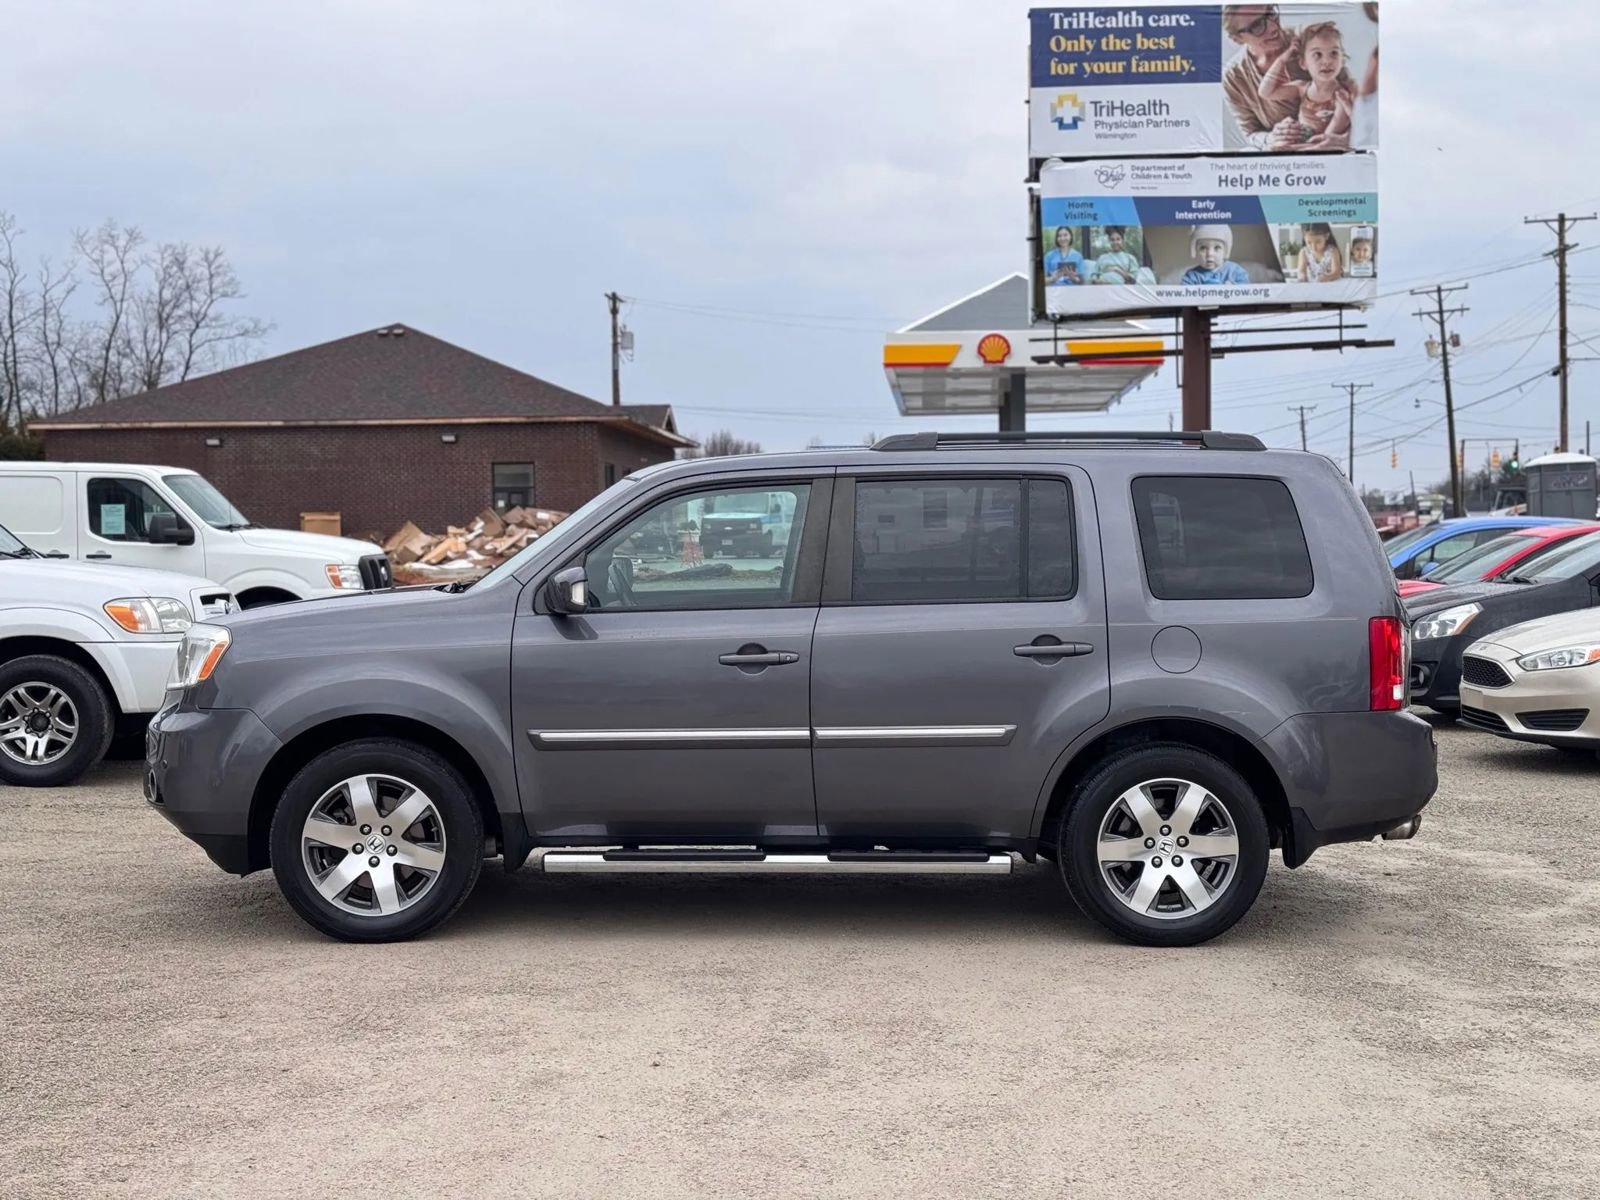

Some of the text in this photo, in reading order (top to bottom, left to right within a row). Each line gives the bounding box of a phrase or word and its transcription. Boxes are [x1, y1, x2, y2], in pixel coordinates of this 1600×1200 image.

[1049, 10, 1196, 30] TriHealth care.
[1049, 32, 1176, 56] Only the best
[1050, 54, 1196, 79] for your family.
[1089, 99, 1170, 118] TriHealth
[1094, 118, 1190, 131] Physician Partners
[1131, 164, 1185, 173] Department of
[1210, 162, 1225, 171] The
[1226, 161, 1248, 171] heart
[1250, 161, 1258, 170] of
[1259, 161, 1291, 172] thriving
[1171, 172, 1193, 180] Youth
[1217, 172, 1327, 190] Help Me Grow
[1068, 201, 1094, 209] Home
[1191, 199, 1215, 210] Early
[1298, 196, 1367, 208] Developmental
[1064, 211, 1098, 221] Visiting
[1175, 210, 1232, 220] Intervention
[1307, 207, 1357, 218] Screenings
[1156, 287, 1270, 299] www.helpmegrow.org
